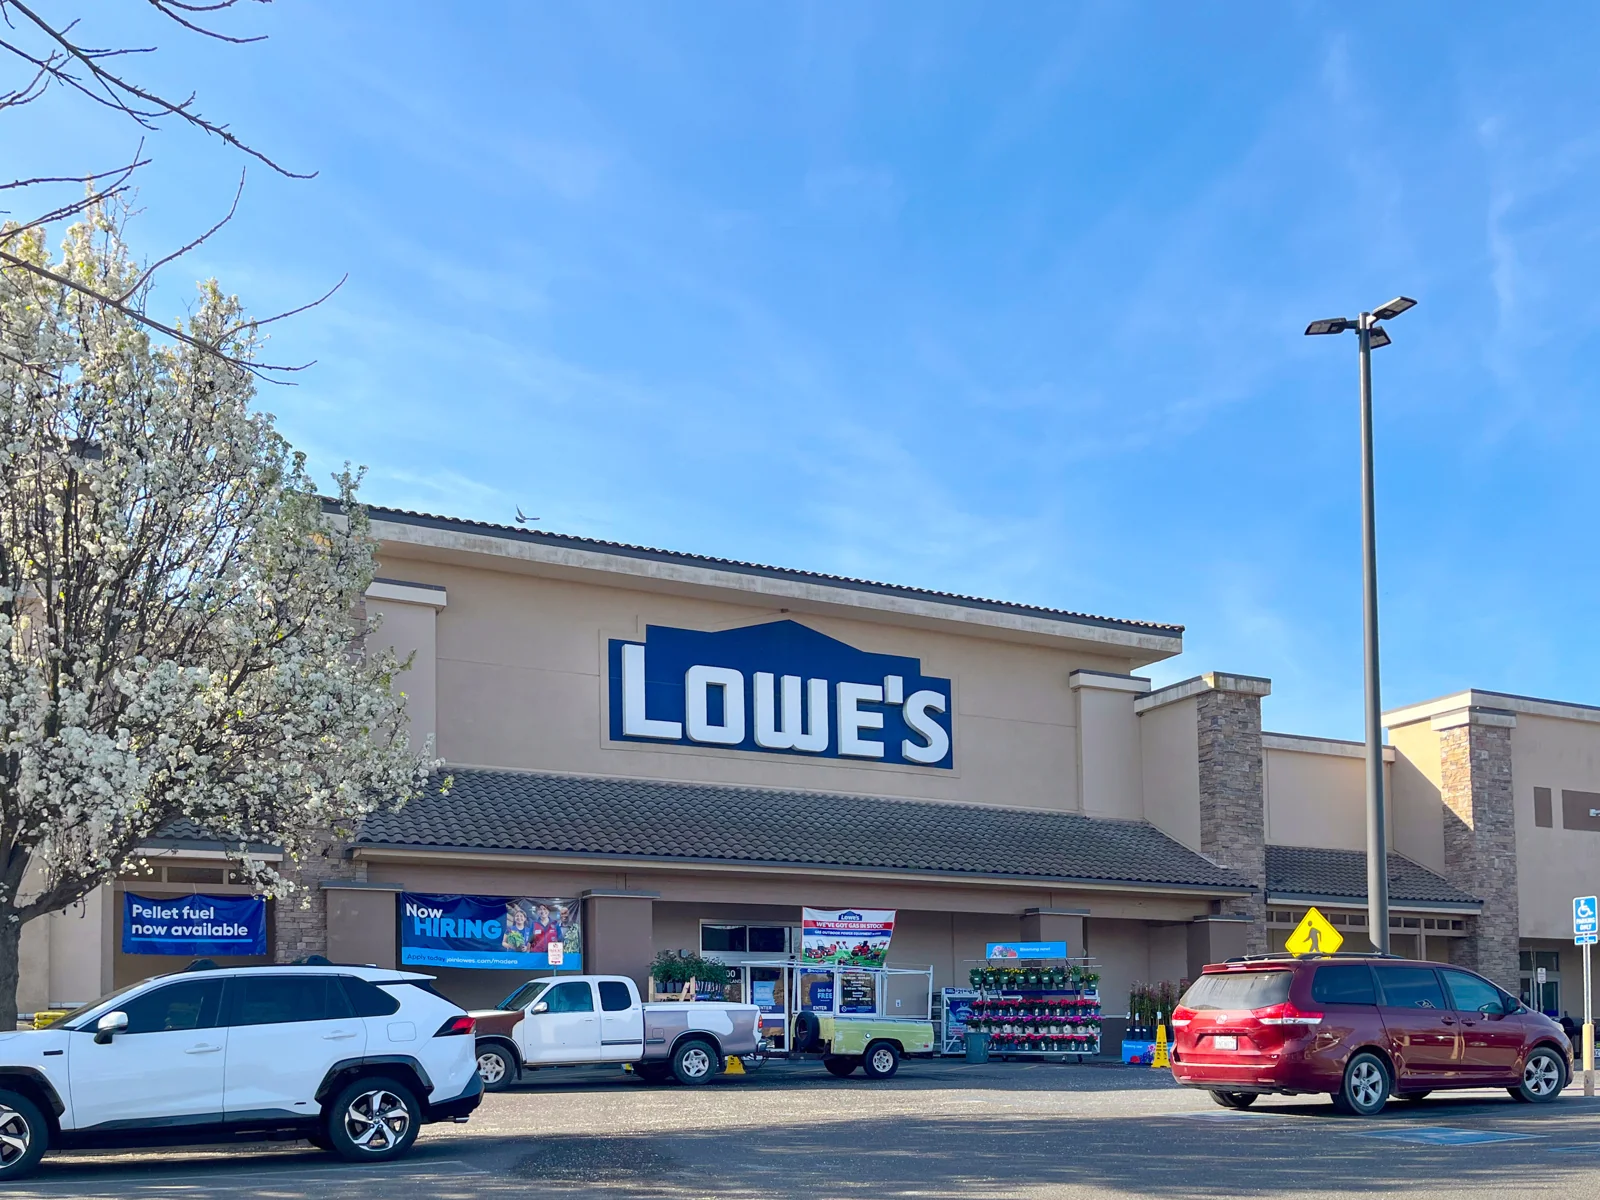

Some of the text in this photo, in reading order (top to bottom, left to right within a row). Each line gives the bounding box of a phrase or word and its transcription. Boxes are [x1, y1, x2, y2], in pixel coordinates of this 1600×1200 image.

[621, 643, 950, 764] LOWE'S
[132, 904, 215, 919] Pellet fuel
[131, 923, 248, 936] now available
[414, 917, 502, 940] HIRING
[407, 953, 426, 961] Apply
